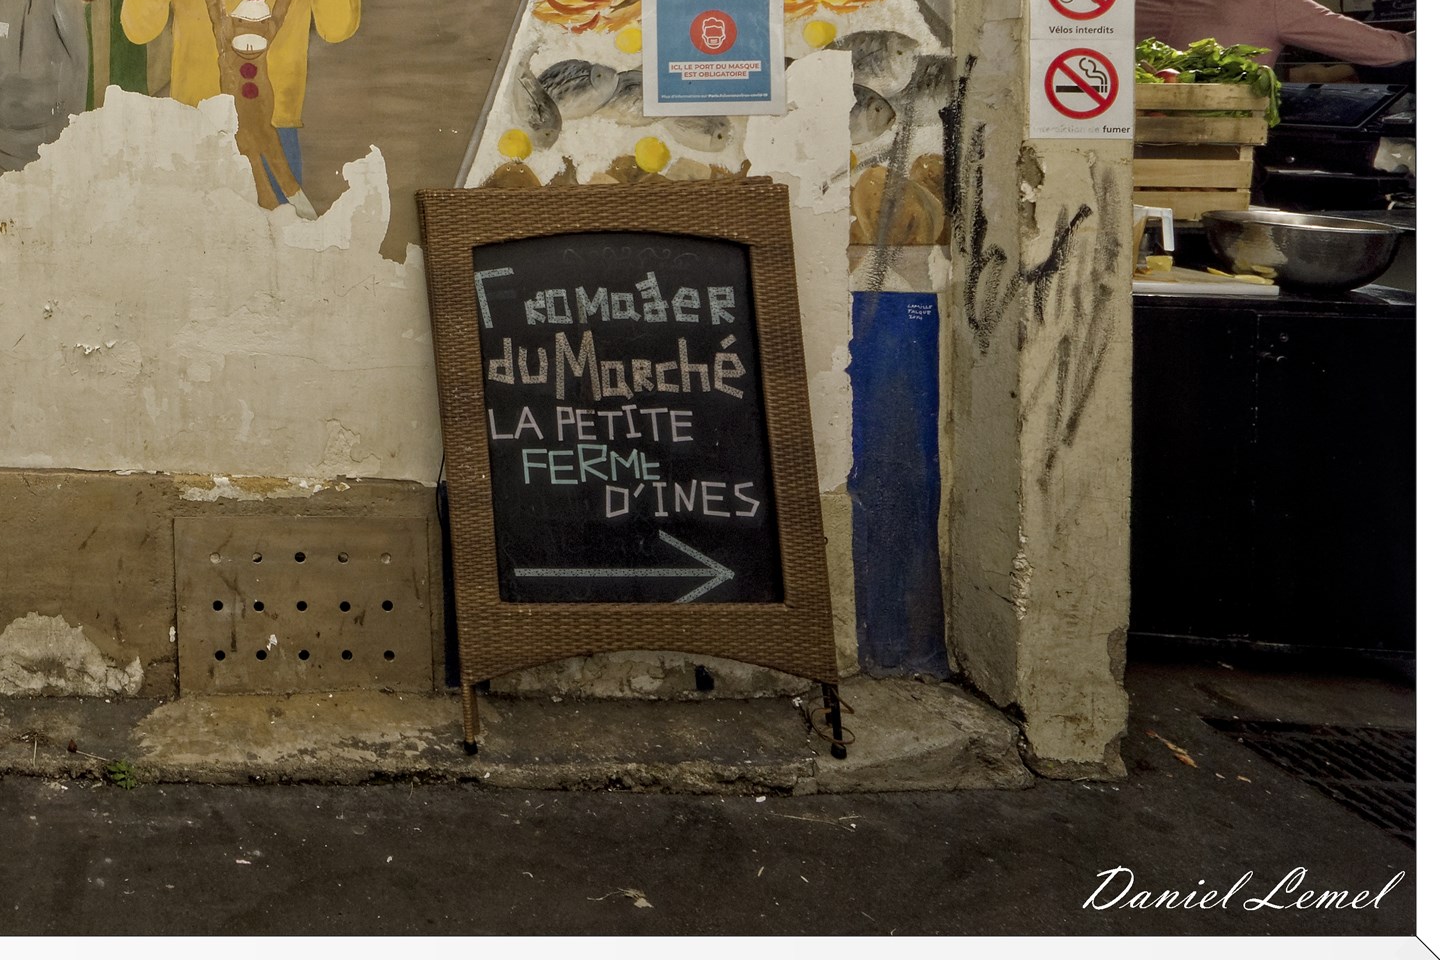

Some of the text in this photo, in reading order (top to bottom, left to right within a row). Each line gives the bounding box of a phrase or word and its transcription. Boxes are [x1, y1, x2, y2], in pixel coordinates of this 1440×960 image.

[1048, 25, 1114, 35] Vélos interdits
[1102, 125, 1131, 134] fumer
[488, 337, 549, 385] du
[488, 404, 694, 442] LA PETITE
[522, 444, 662, 484] FERME
